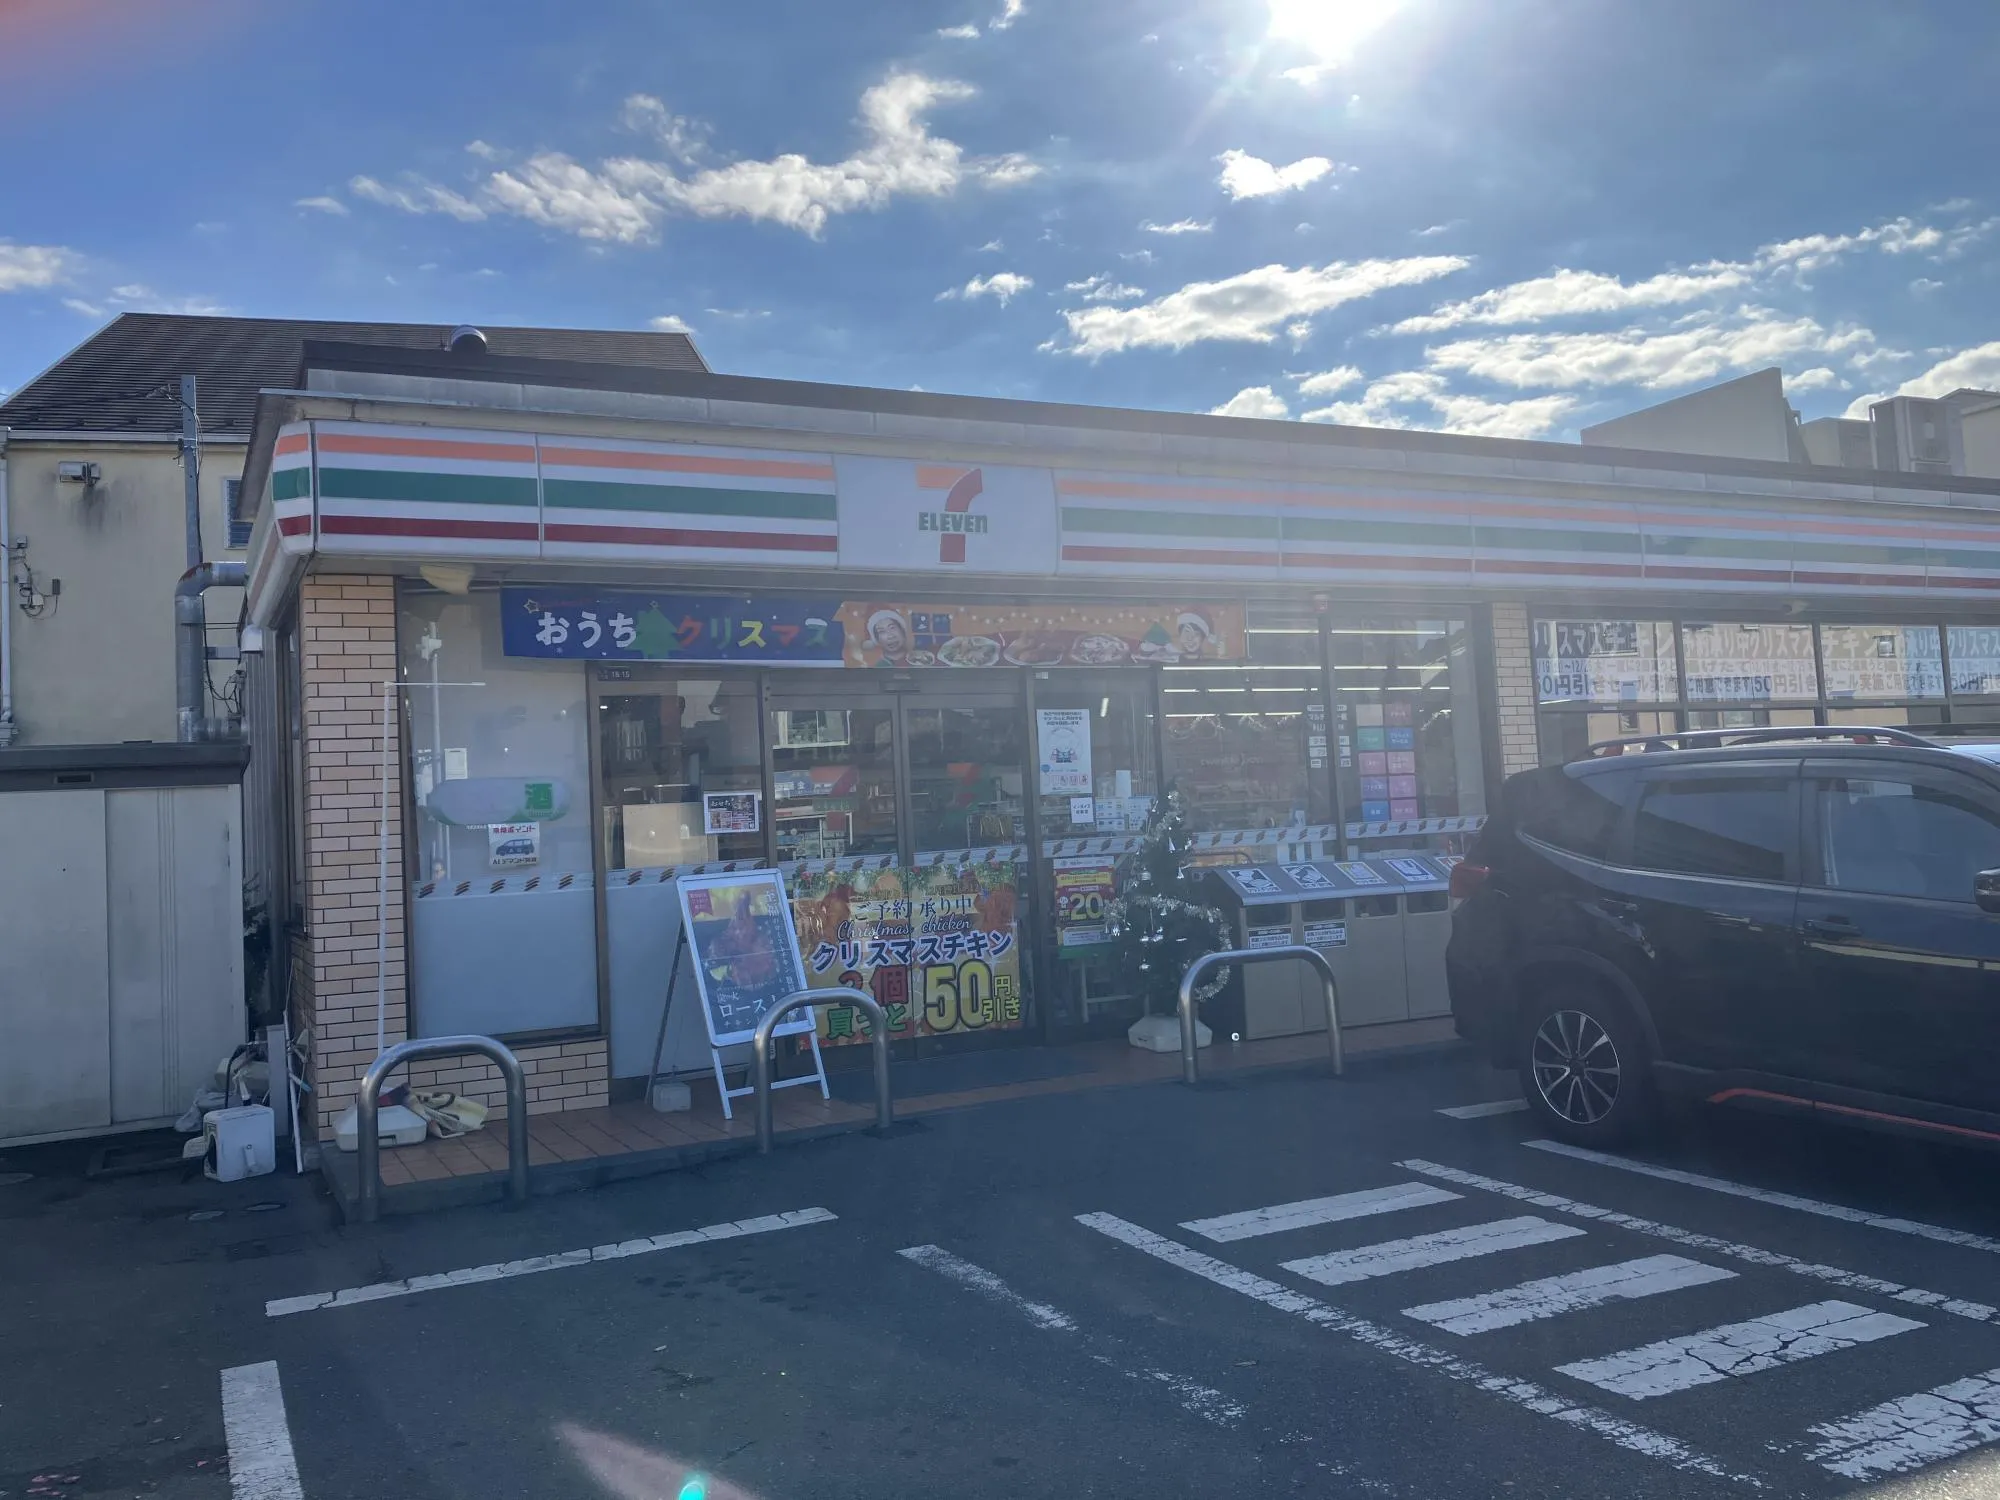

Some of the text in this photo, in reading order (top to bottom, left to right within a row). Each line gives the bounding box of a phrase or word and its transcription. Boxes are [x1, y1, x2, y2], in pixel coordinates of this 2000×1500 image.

[536, 612, 829, 650] おうち クリスマス
[854, 895, 974, 921] ご予約 承り中
[922, 914, 971, 933] chicken
[811, 929, 1013, 974] クリスマスチキン
